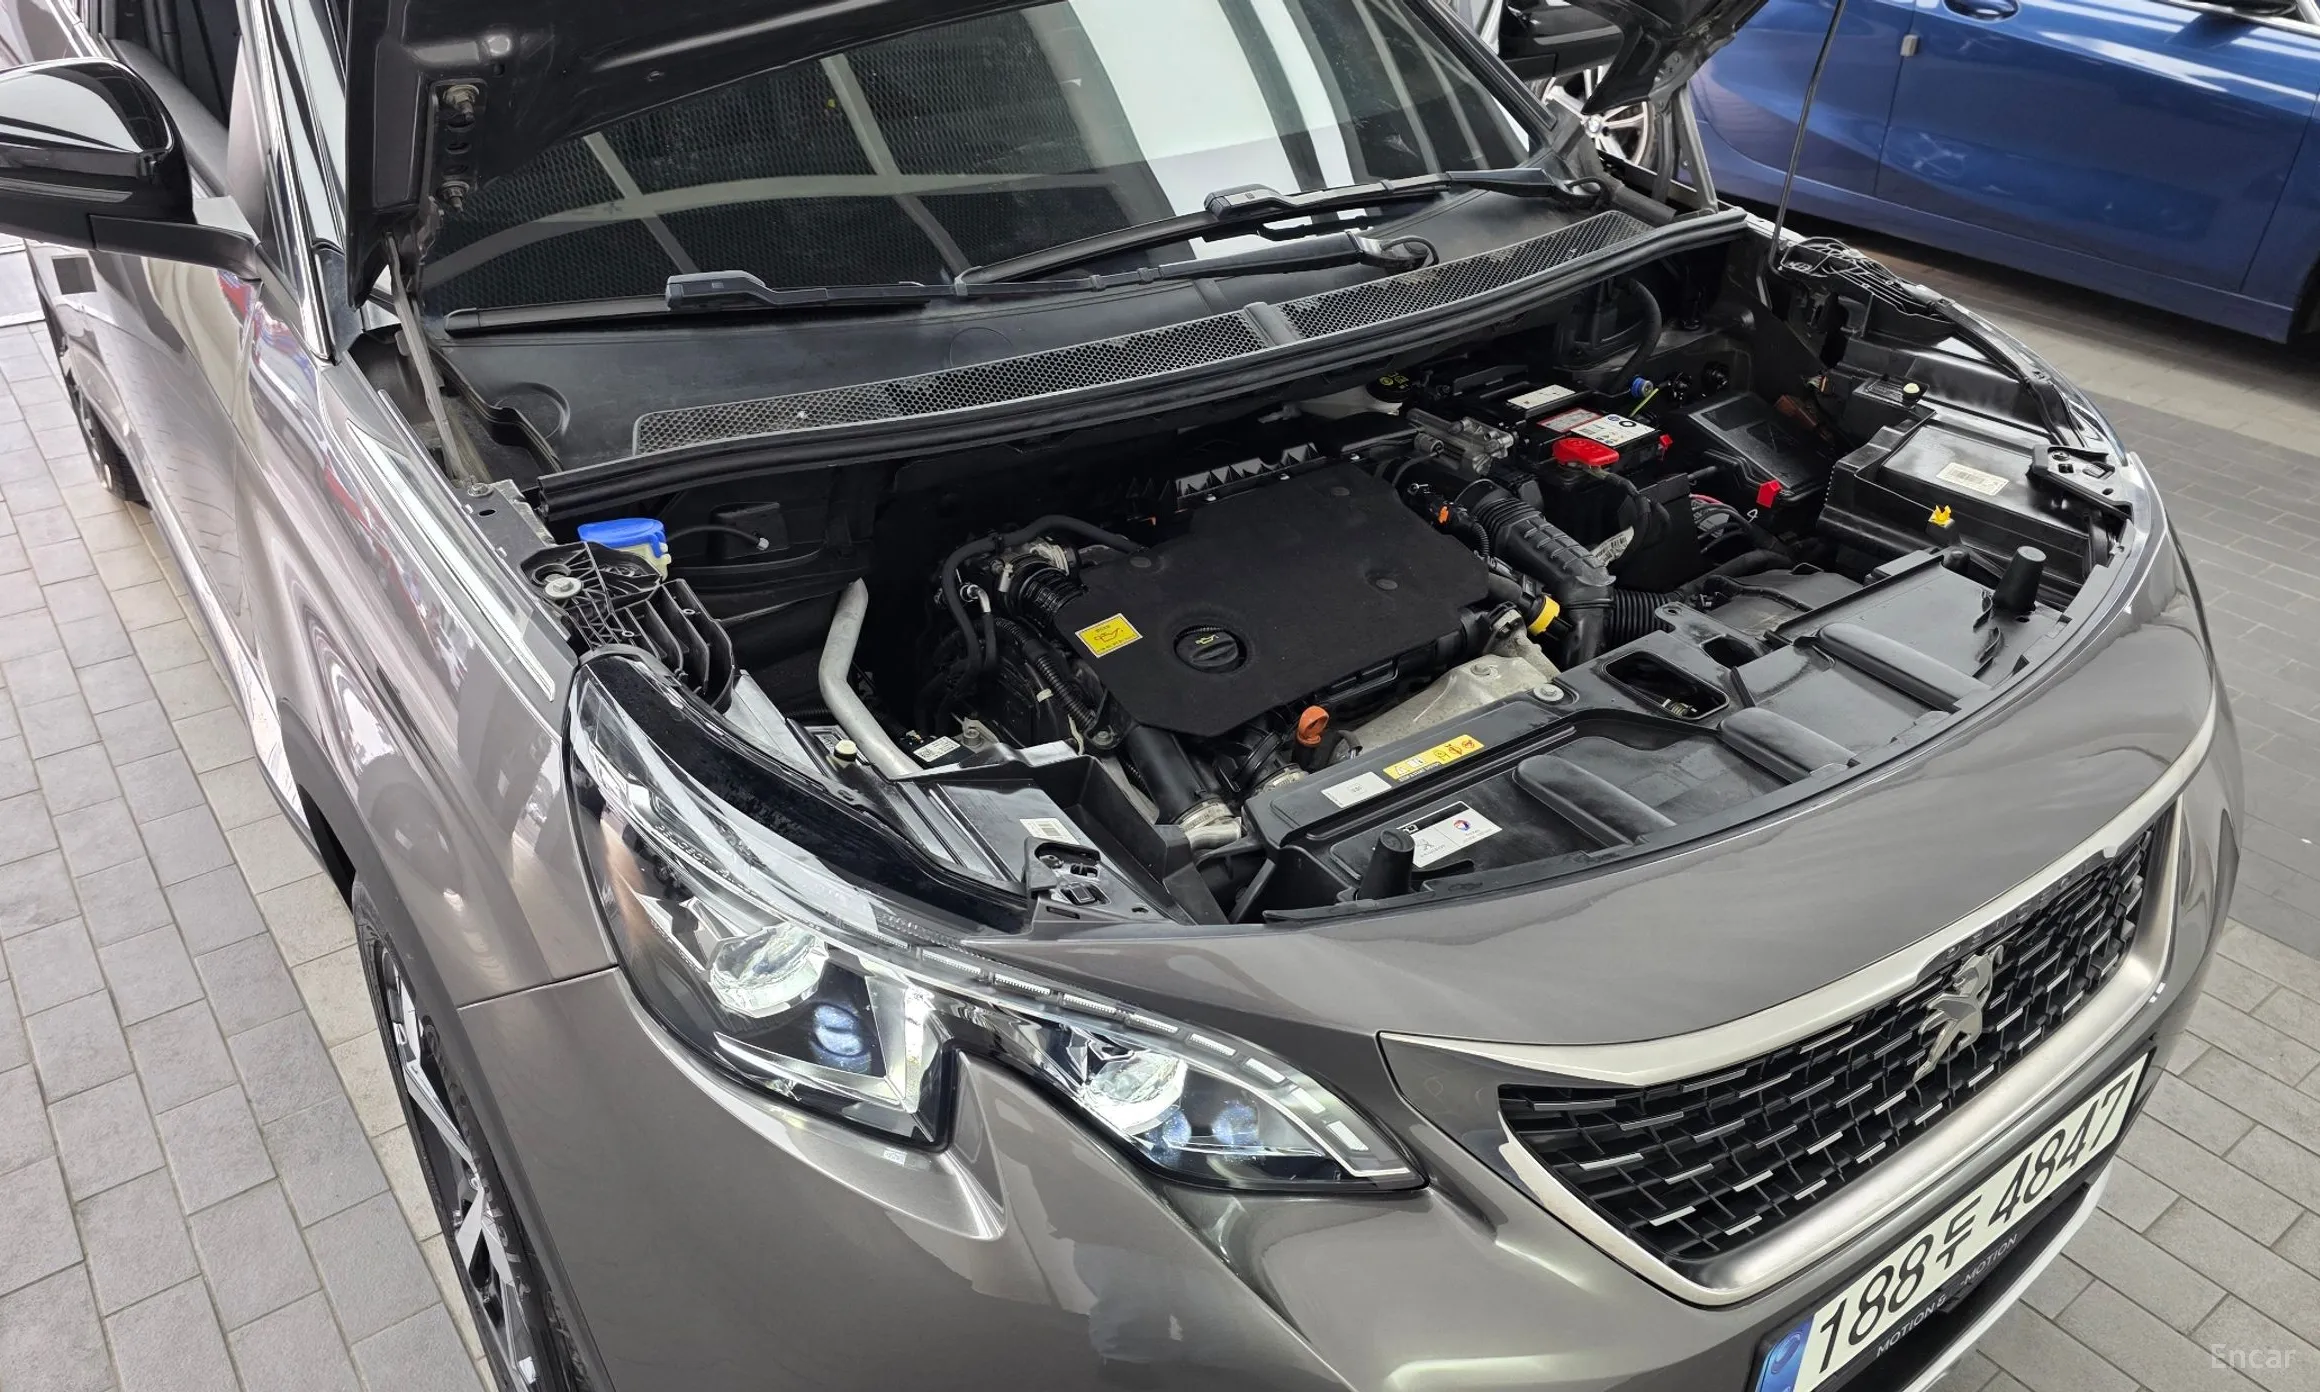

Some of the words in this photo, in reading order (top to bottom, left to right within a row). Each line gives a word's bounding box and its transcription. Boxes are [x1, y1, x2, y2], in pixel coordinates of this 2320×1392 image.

[1818, 1193, 1982, 1374] 188두
[1987, 1070, 2134, 1227] 4847
[1876, 1301, 1936, 1357] MOTION
